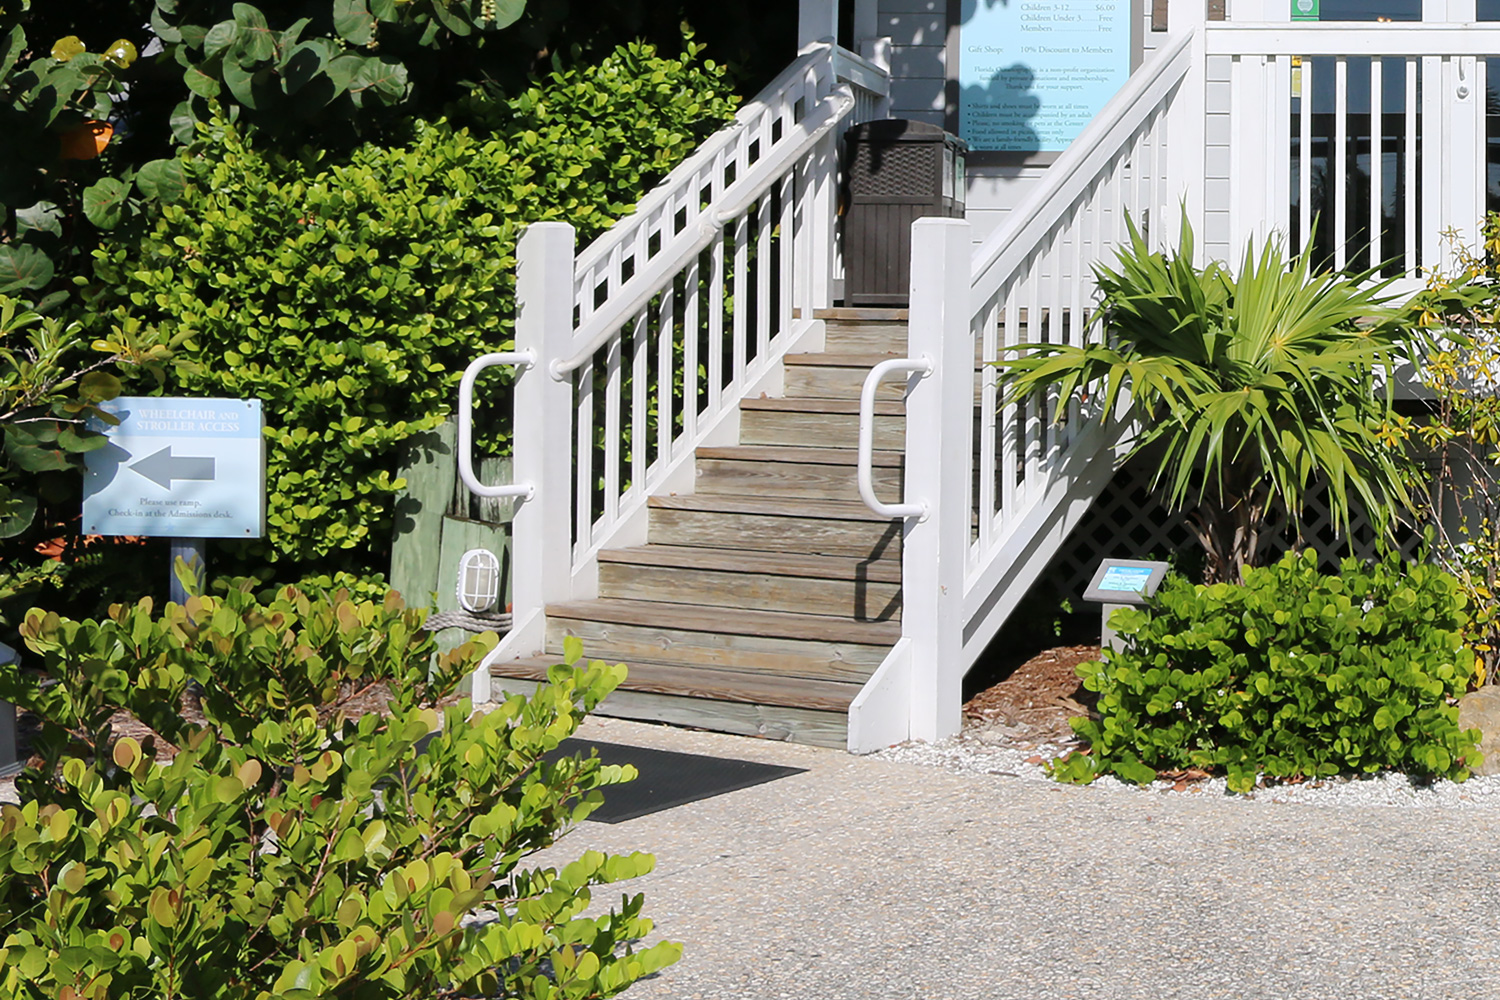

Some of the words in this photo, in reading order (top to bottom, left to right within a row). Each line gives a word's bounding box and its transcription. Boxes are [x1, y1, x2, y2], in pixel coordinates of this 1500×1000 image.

[1020, 3, 1051, 11] Children
[1053, 3, 1069, 11] 3-12
[1095, 3, 1116, 12] $6.00
[1020, 13, 1051, 22] Children
[1053, 13, 1075, 22] Under
[1099, 13, 1113, 22] Free
[1020, 24, 1052, 32] Members
[1098, 24, 1112, 32] Free
[1050, 66, 1079, 75] non-profit
[1080, 66, 1115, 75] organization
[138, 408, 216, 420] WHEELCHAIR
[218, 412, 239, 421] AND
[136, 421, 194, 431] STROLLER
[199, 422, 240, 433] ACCESS
[139, 498, 163, 506] Please
[179, 500, 202, 508] ramp.
[108, 508, 143, 517] Check-in
[145, 509, 152, 517] at
[154, 508, 166, 517] the
[168, 509, 212, 518] Admissions
[213, 510, 233, 519] desk.
